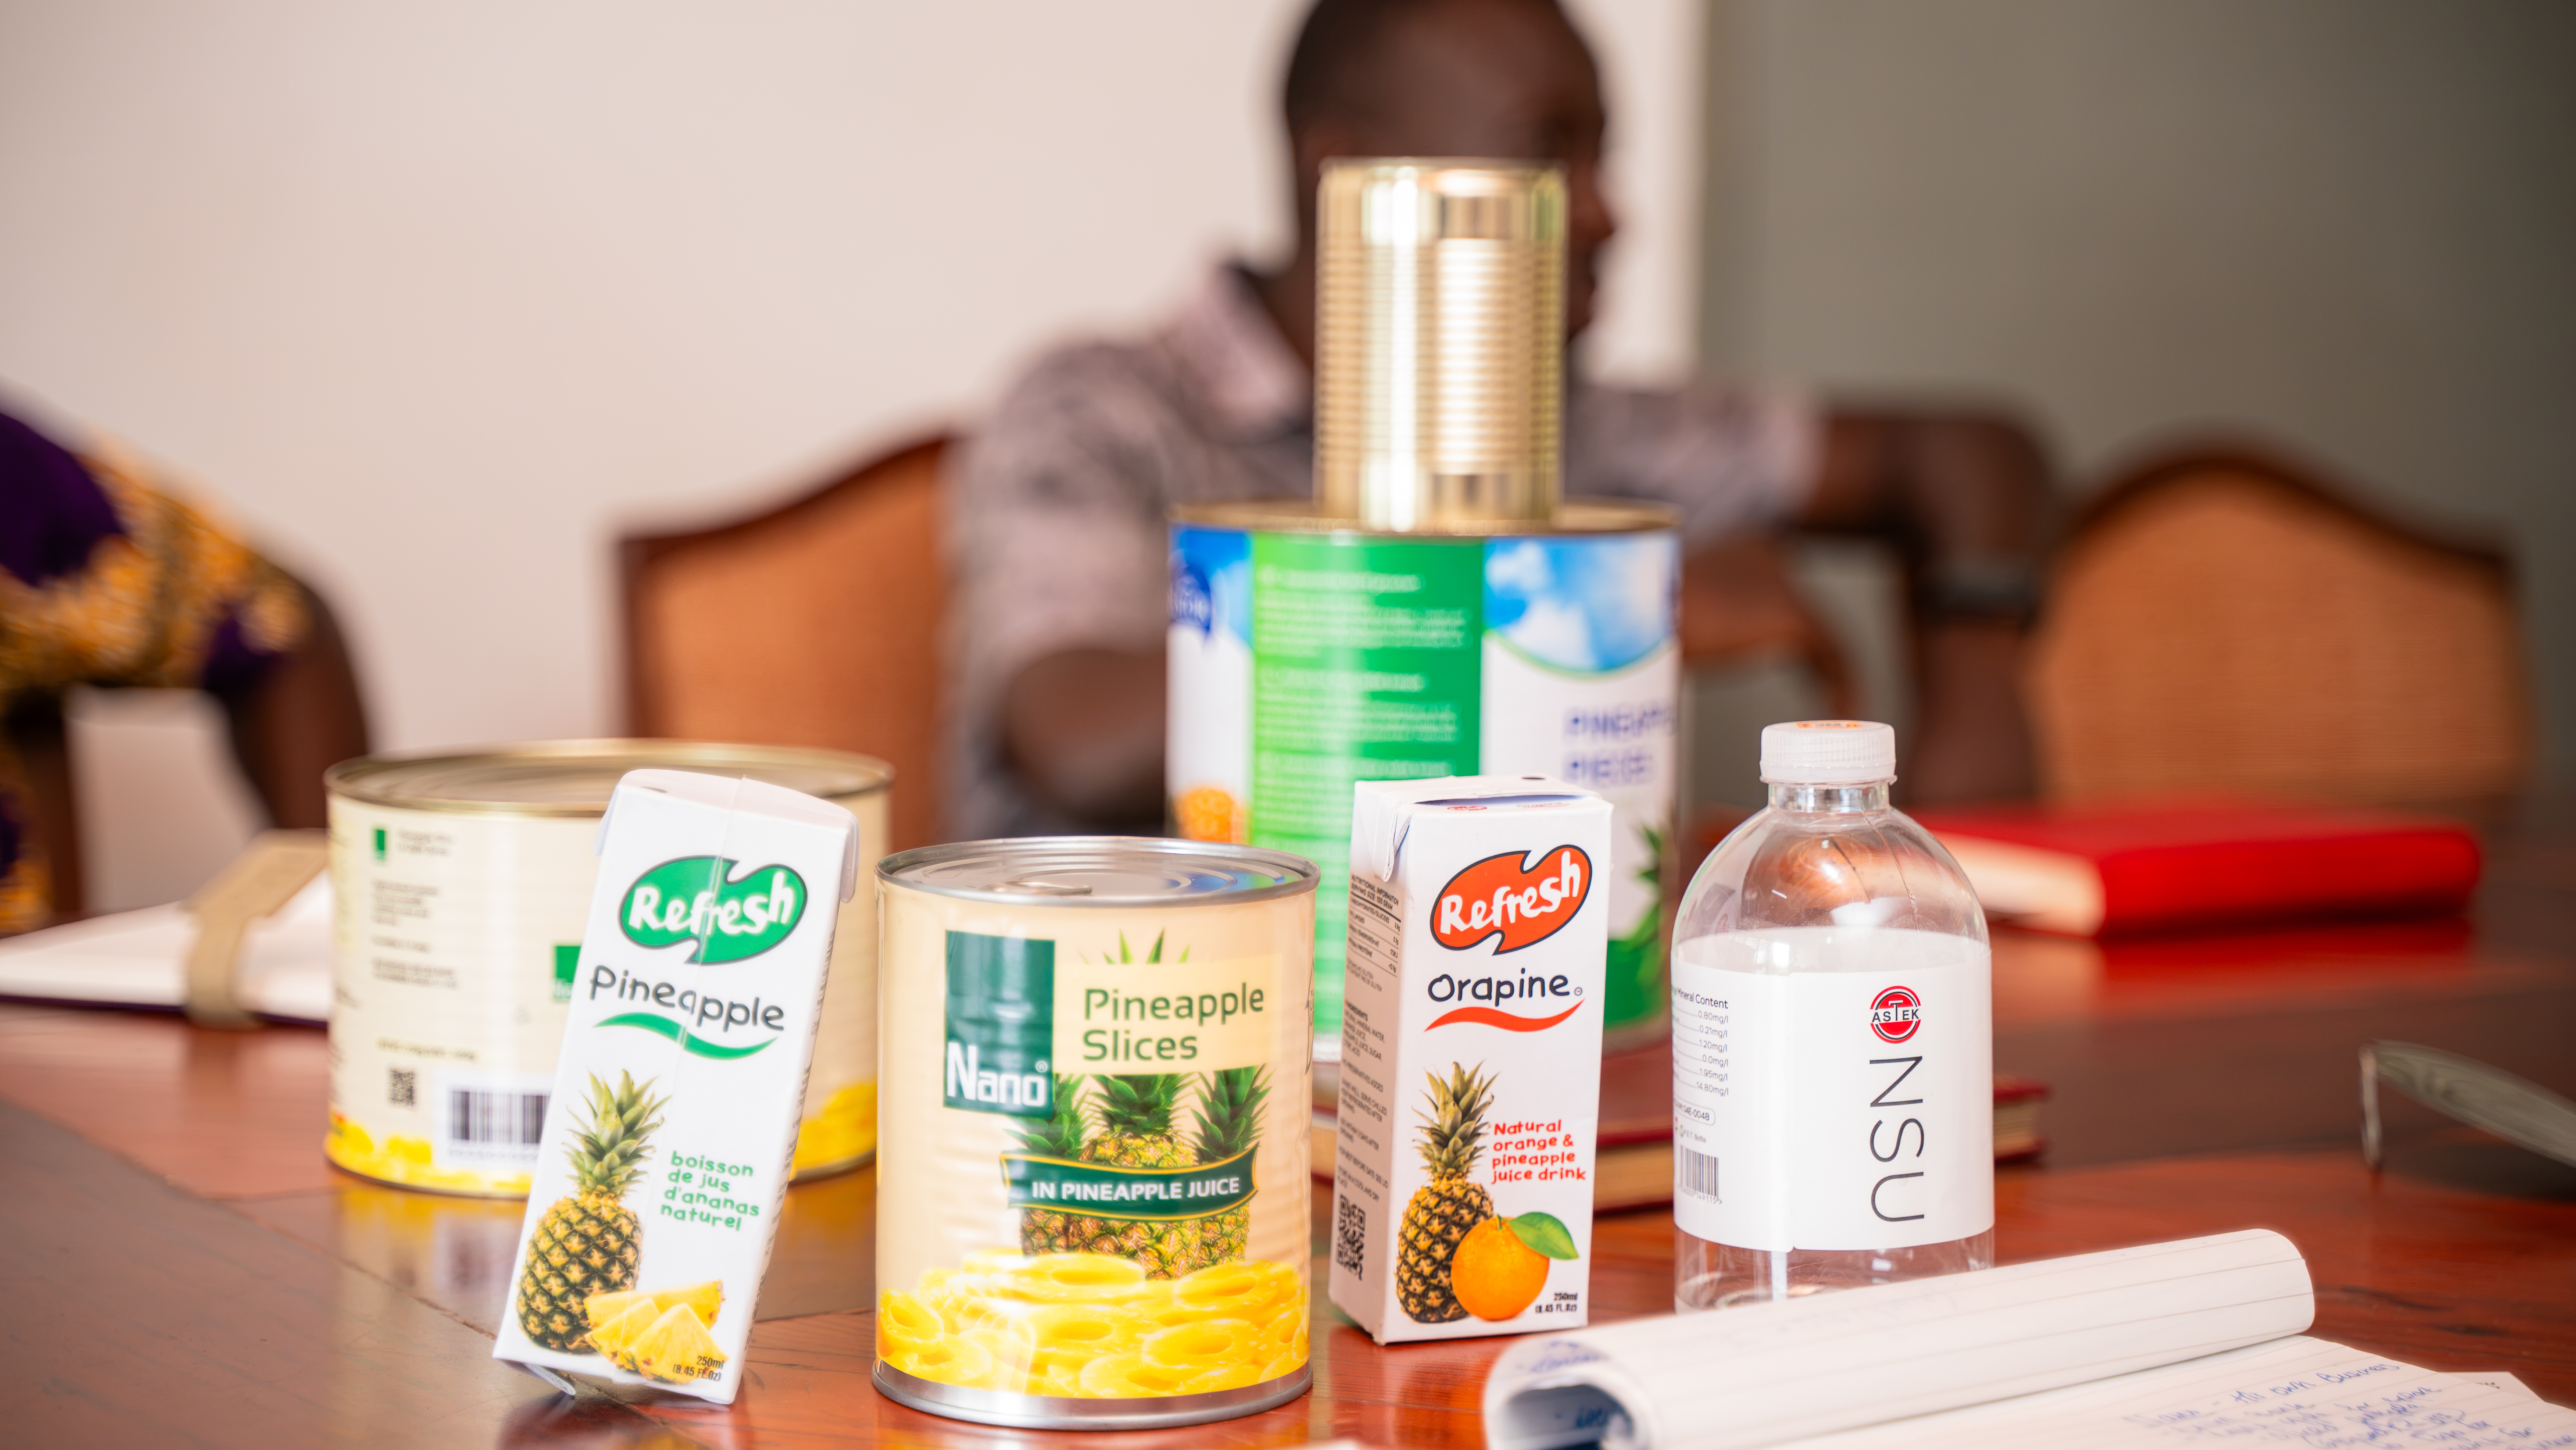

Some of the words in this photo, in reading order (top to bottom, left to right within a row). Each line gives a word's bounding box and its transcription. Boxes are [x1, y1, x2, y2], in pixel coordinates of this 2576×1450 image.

[628, 871, 794, 936] Refresh
[1440, 850, 1581, 935] Refresh
[589, 965, 784, 1032] Pineapple
[1428, 968, 1570, 1007] Orapine
[1083, 983, 1264, 1026] Pineapple
[1696, 994, 1728, 1009] Content
[1872, 1000, 1920, 1022] ASTEK
[1698, 1010, 1728, 1024] 0.80mg/l
[1699, 1025, 1728, 1039] 0.21mg/l
[1083, 1031, 1198, 1061] Slices
[1702, 1054, 1728, 1068] 0.0mg/l
[947, 1042, 1046, 1106] Nano
[1493, 1119, 1561, 1136] Natural
[1869, 1056, 1925, 1222] NSU
[1493, 1137, 1557, 1151] orange
[1563, 1134, 1573, 1147] &
[670, 1150, 754, 1177] boisson
[1492, 1151, 1575, 1169] pineapple
[668, 1168, 693, 1184] de
[698, 1173, 730, 1193] jus
[1032, 1181, 1055, 1200] IN
[1062, 1181, 1182, 1201] PINEAPPLE
[1187, 1176, 1240, 1199] JUICE
[1491, 1169, 1532, 1185] juice
[1538, 1167, 1586, 1180] drink
[664, 1186, 759, 1217] d'ananas
[660, 1204, 742, 1232] naturel
[696, 1356, 724, 1369] 250ml
